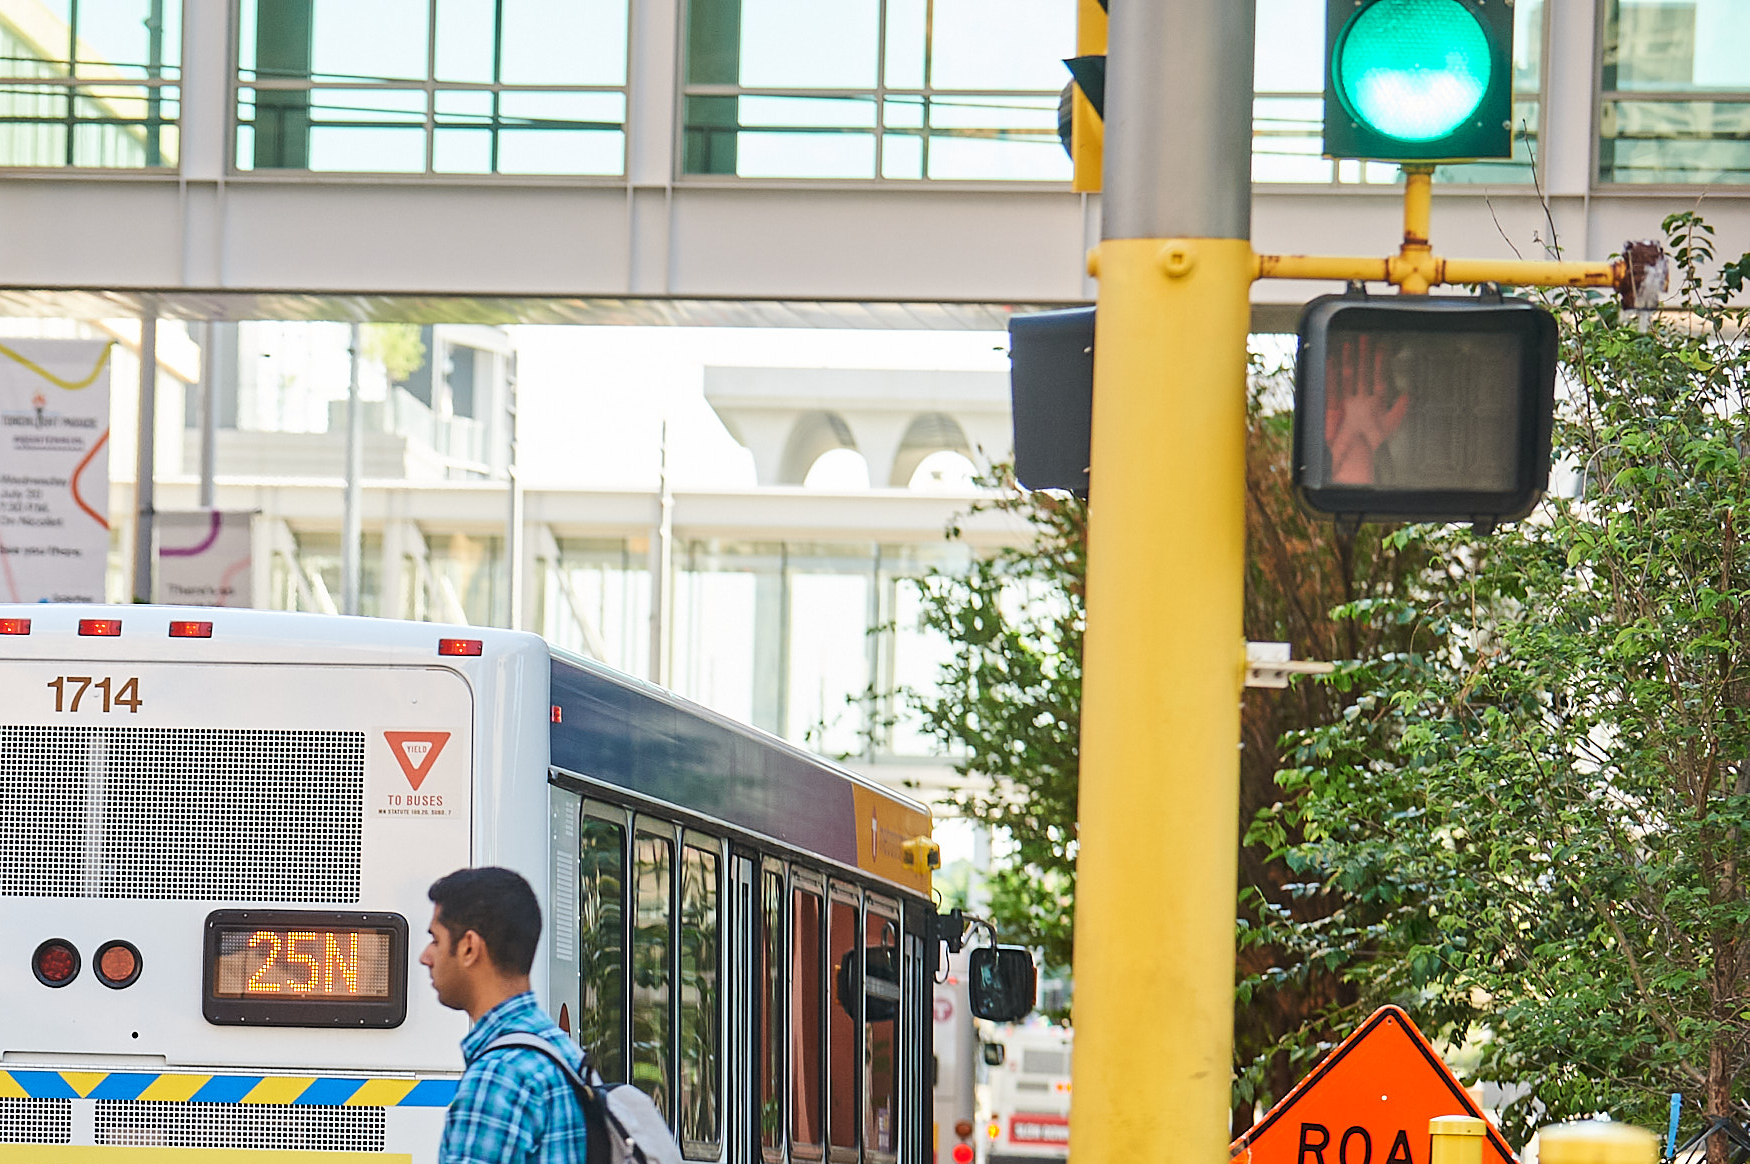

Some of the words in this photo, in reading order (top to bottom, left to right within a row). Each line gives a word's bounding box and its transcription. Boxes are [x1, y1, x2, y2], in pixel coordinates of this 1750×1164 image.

[47, 676, 143, 713] 1714
[407, 745, 428, 754] YIELD
[388, 794, 402, 806] TO
[406, 795, 443, 807] BUSES
[248, 930, 359, 994] 25N
